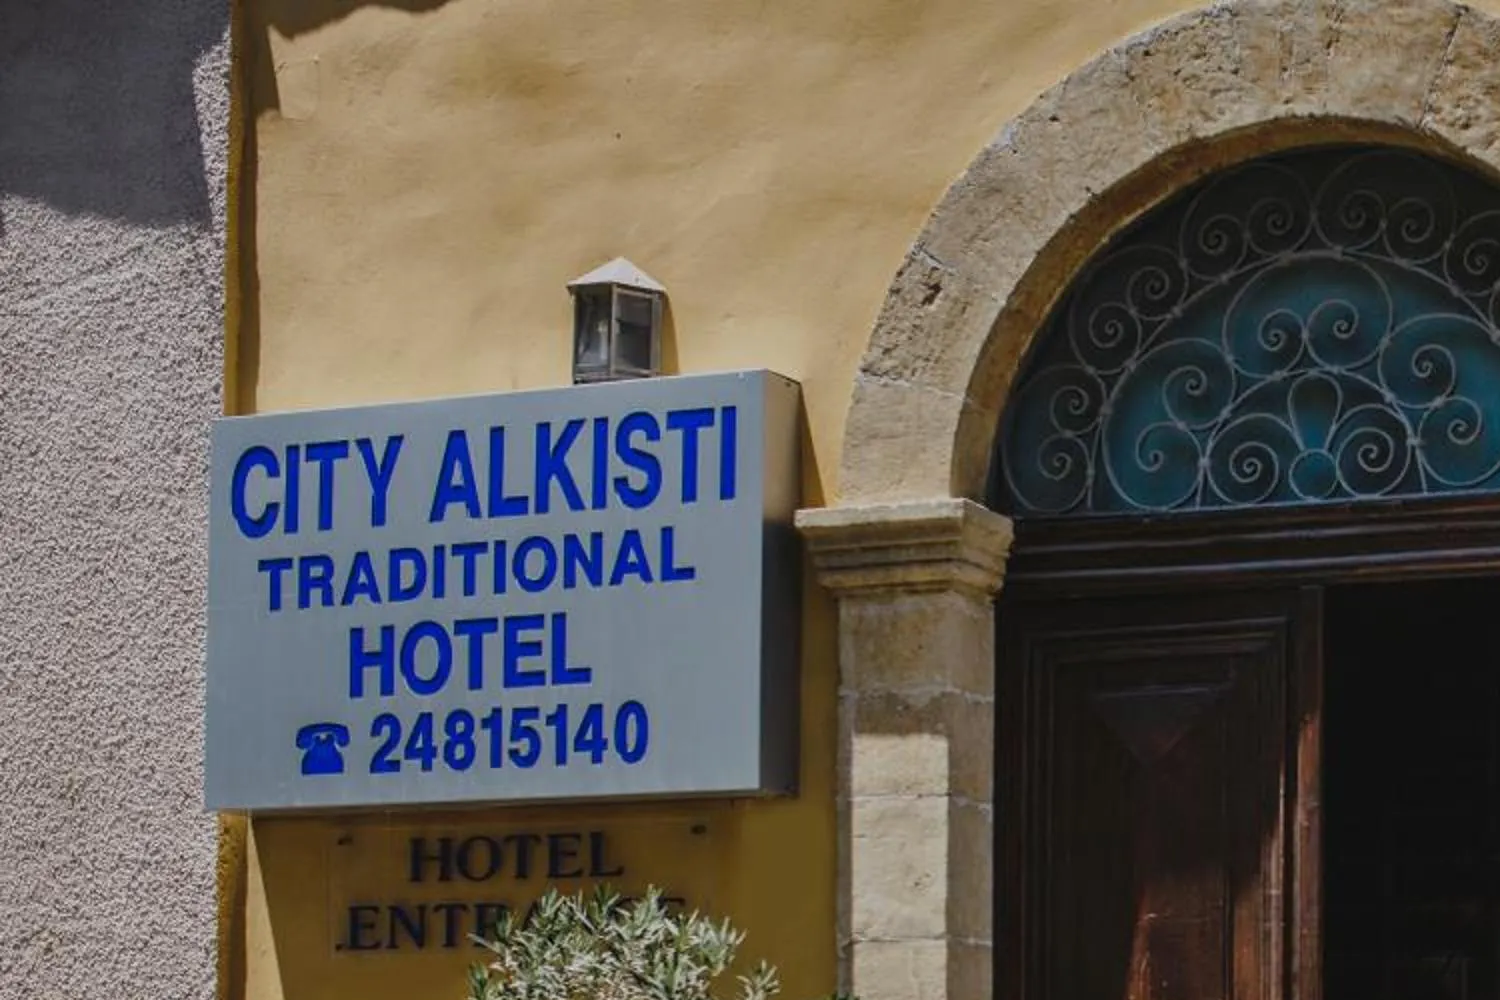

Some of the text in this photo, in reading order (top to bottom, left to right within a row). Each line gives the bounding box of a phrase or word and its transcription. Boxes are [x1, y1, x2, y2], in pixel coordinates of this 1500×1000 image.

[230, 405, 738, 539] CITY ALKISTI
[257, 525, 697, 613] TRADITIONAL
[348, 612, 593, 699] HOTEL
[368, 700, 650, 775] 24815140
[408, 831, 625, 883] HOTEL
[343, 896, 686, 951] ENTR
